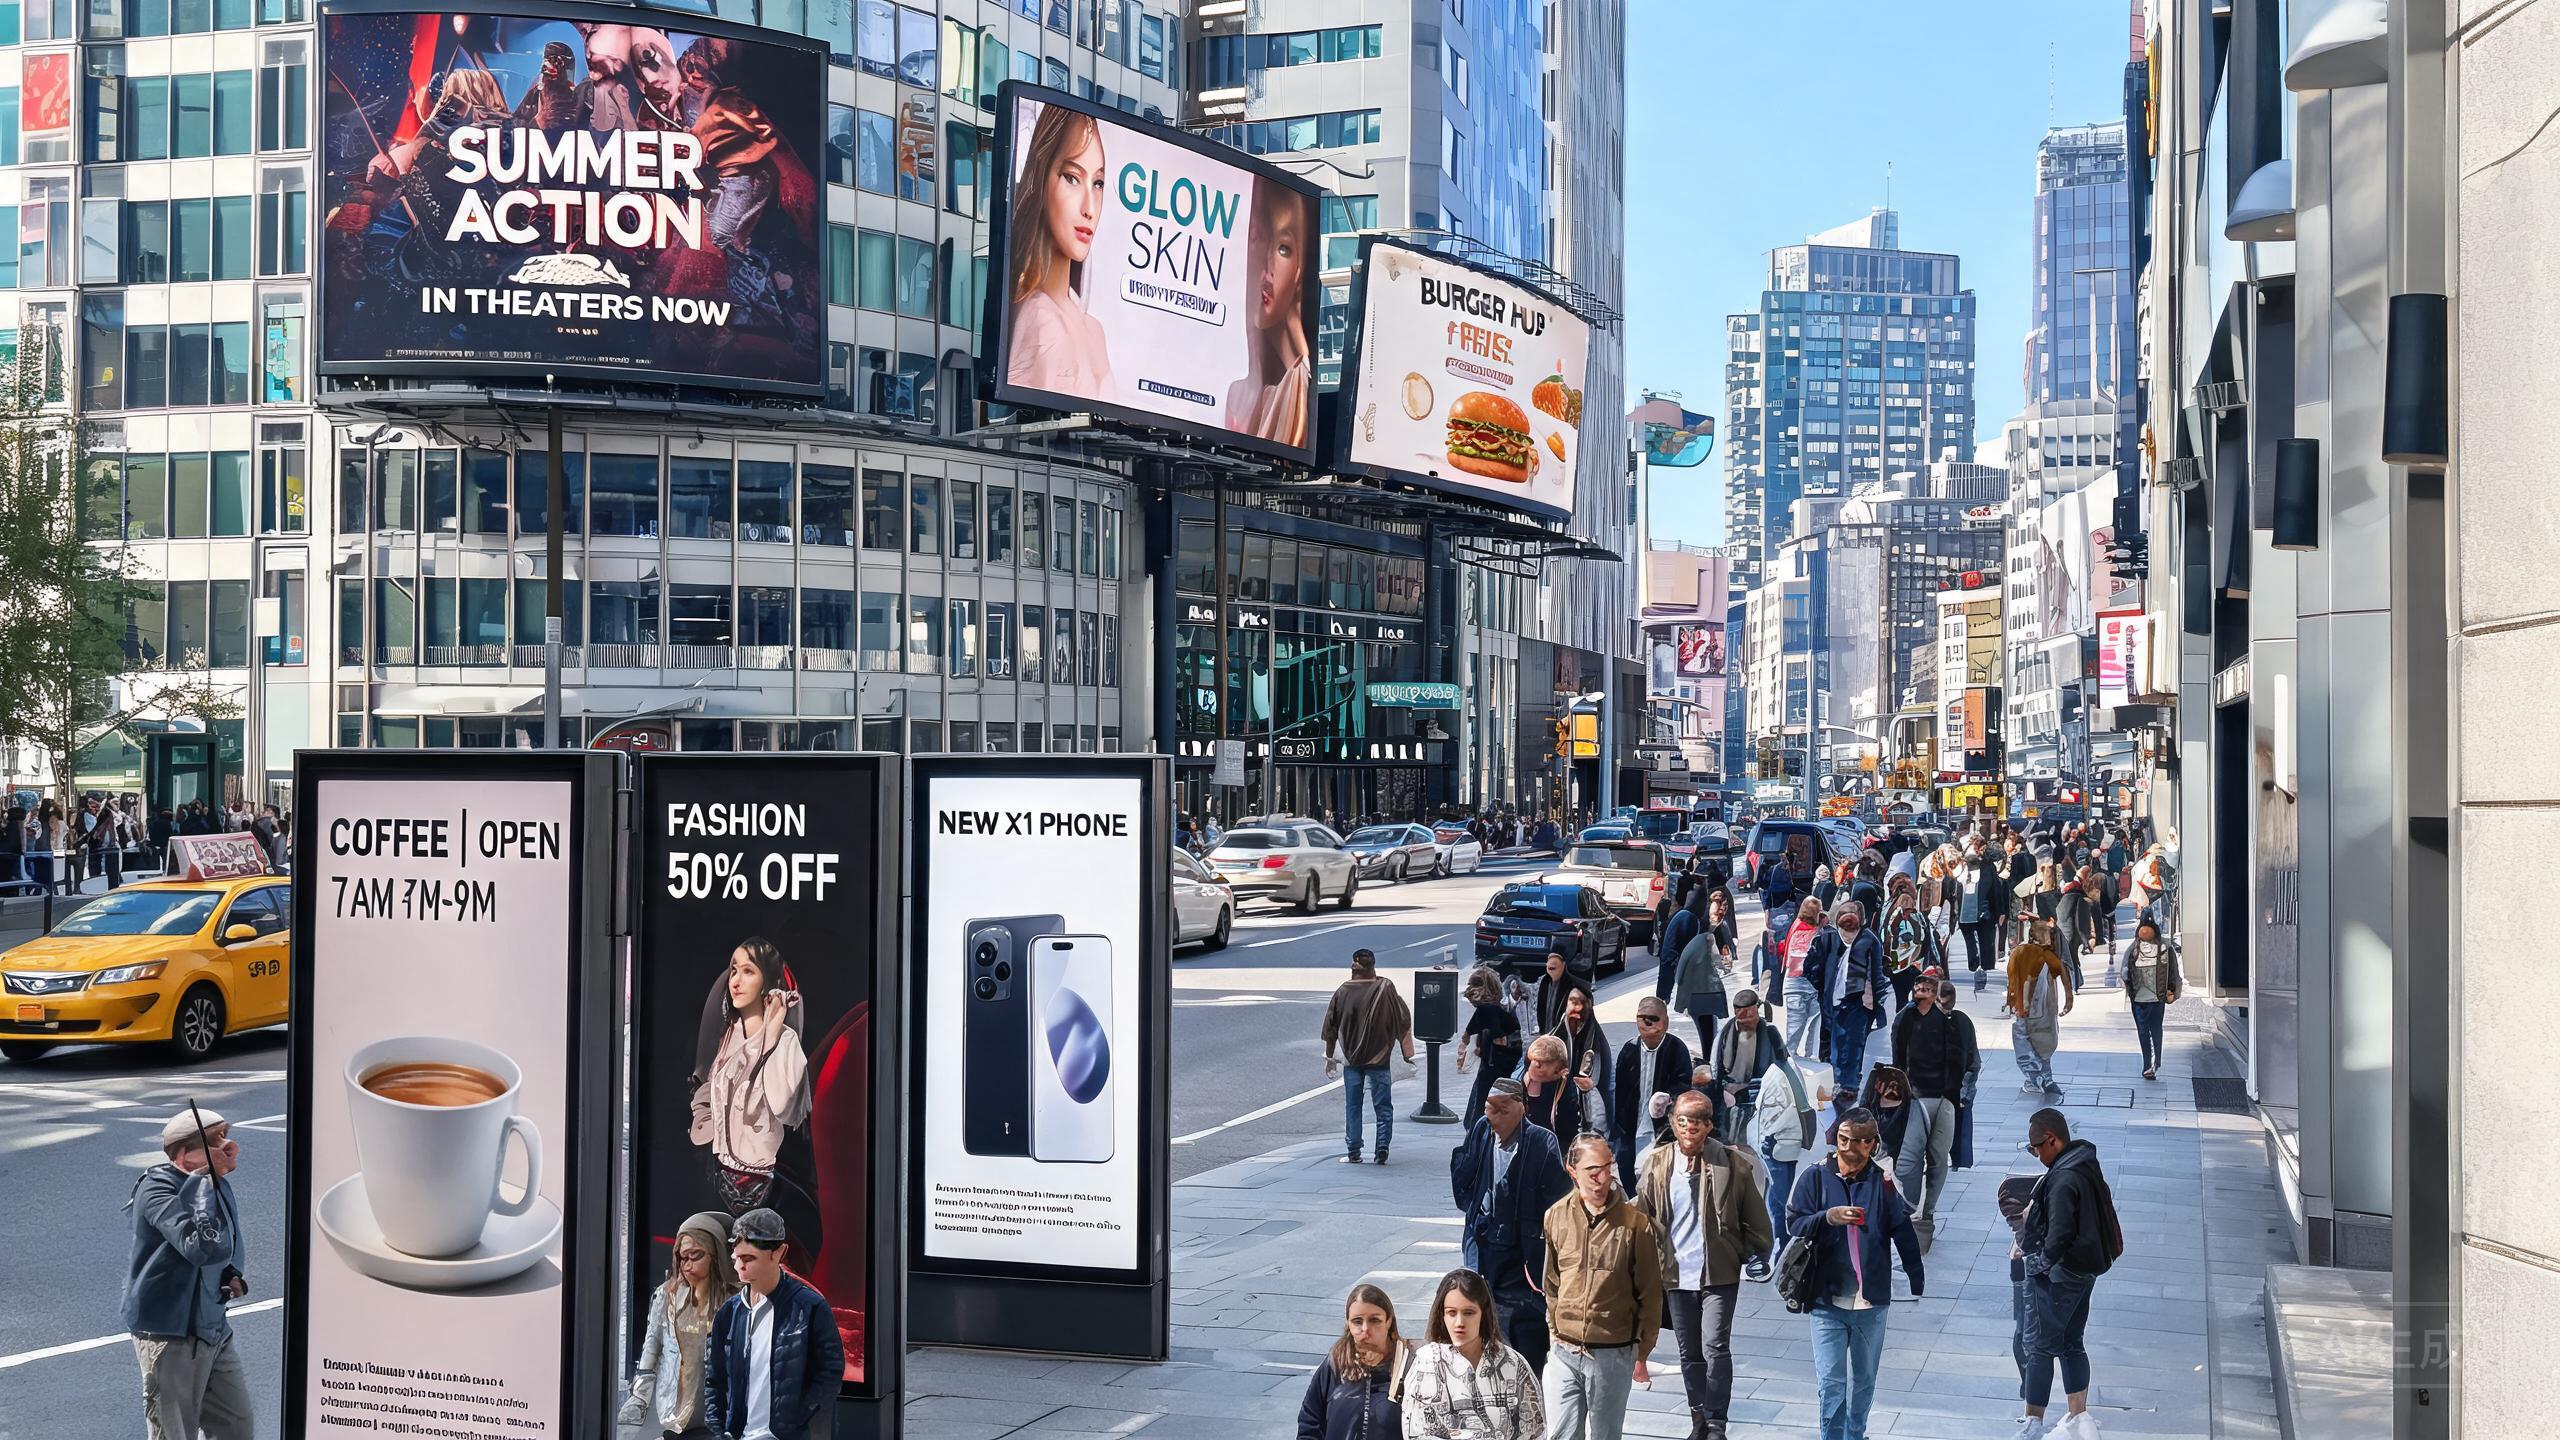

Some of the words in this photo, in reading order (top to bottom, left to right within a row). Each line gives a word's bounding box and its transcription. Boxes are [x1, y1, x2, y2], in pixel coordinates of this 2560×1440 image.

[445, 126, 704, 190] SUMMER
[445, 188, 702, 250] ACTION
[1118, 162, 1240, 239] GLOW
[1128, 221, 1225, 291] SKIN
[422, 287, 456, 313] IN
[464, 288, 644, 320] THEATERS
[652, 296, 731, 326] NOW
[1421, 277, 1506, 323] BURGER
[330, 818, 448, 858] COFFEE
[479, 820, 560, 859] OPEN
[668, 803, 805, 837] FASHION
[939, 810, 999, 836] NEW
[1005, 811, 1032, 836] X1
[1040, 812, 1128, 837] PHONE
[331, 876, 394, 920] 7AM
[667, 852, 748, 900] 50%
[760, 852, 839, 901] OFF
